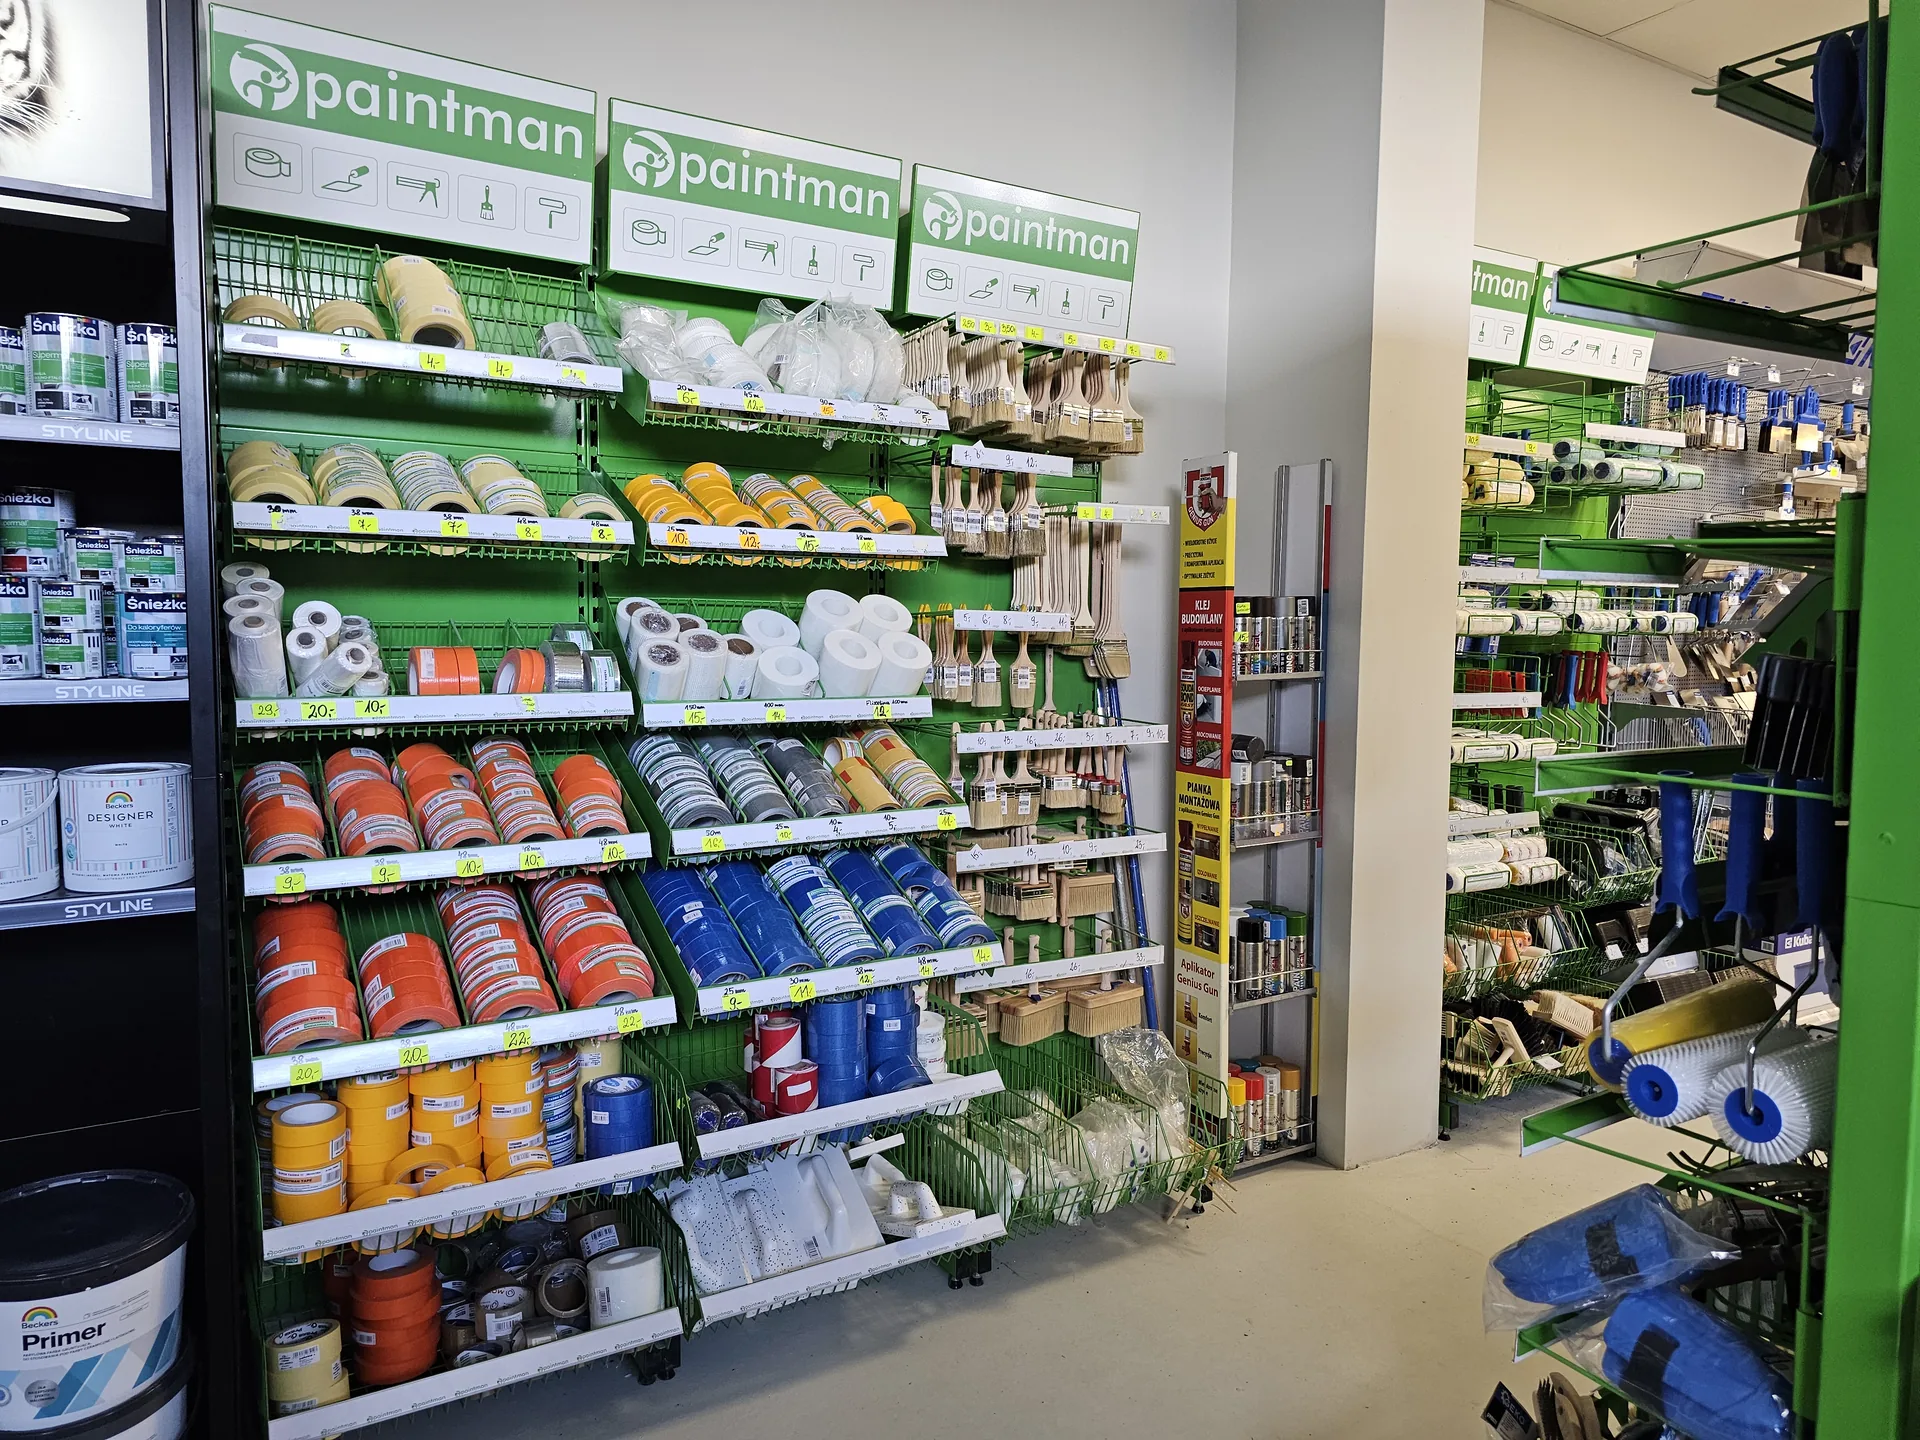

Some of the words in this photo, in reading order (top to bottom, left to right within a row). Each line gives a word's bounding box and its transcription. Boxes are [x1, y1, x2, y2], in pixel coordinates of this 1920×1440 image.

[306, 70, 583, 159] paintman
[680, 150, 890, 219] paintman
[965, 206, 1129, 265] paintman
[41, 424, 133, 443] STYLINE
[1188, 506, 1203, 526] GENIUS
[1203, 516, 1214, 526] GUN
[76, 541, 109, 549] Śnieżka
[125, 545, 162, 555] Śnieżka
[42, 588, 73, 596] Śnieżka
[1195, 600, 1210, 611] KLEJ
[1181, 613, 1223, 625] BUDOWLANY
[140, 624, 182, 633] kaloryferów
[42, 636, 70, 644] Śnieżka
[55, 685, 146, 699] STYLINE
[1197, 686, 1222, 694] OCIEPLANIE
[308, 704, 335, 719] 20,-
[364, 699, 387, 714] 10,-
[1196, 731, 1221, 740] MOCOWANIE
[1187, 781, 1212, 796] PIANKA
[1178, 794, 1221, 811] MONTAŻOWA
[87, 811, 154, 822] DESIGNER
[1201, 810, 1213, 818] Genius
[524, 855, 541, 867] 10,-
[607, 847, 625, 861] 10,-
[279, 866, 290, 875] 38
[379, 867, 395, 883] 9,-
[461, 864, 482, 877] 10,-
[283, 877, 301, 892] 9,-
[65, 899, 153, 918] STYLINE
[1181, 958, 1215, 979] Aplikator
[1176, 972, 1203, 991] Genius
[1203, 984, 1219, 998] Gun
[614, 1007, 625, 1016] 48
[1198, 1012, 1213, 1024] Komfort
[622, 1016, 641, 1029] 22,-
[509, 1031, 531, 1048] 22,-
[403, 1048, 428, 1064] 20,-
[296, 1069, 320, 1081] 20,-
[275, 1244, 305, 1255] paintman
[710, 1309, 734, 1320] paintman
[744, 1300, 767, 1311] paintman
[777, 1289, 800, 1300] paintman
[810, 1280, 832, 1291] paintman
[841, 1271, 862, 1282] paintman
[871, 1262, 892, 1273] paintman
[901, 1253, 922, 1264] paintman
[931, 1245, 950, 1256] paintman
[958, 1236, 978, 1247] paintman
[986, 1230, 1004, 1239] paintman
[21, 1320, 58, 1329] Beckers
[22, 1322, 106, 1351] Primer
[326, 1421, 357, 1434] paintman
[372, 1408, 402, 1420] paintman
[418, 1395, 446, 1407] paintman
[461, 1382, 490, 1395] paintman
[503, 1371, 529, 1382] paintman
[543, 1359, 569, 1371] paintman
[582, 1348, 608, 1360] paintman
[620, 1337, 645, 1349] paintman
[657, 1327, 681, 1338] paintman
